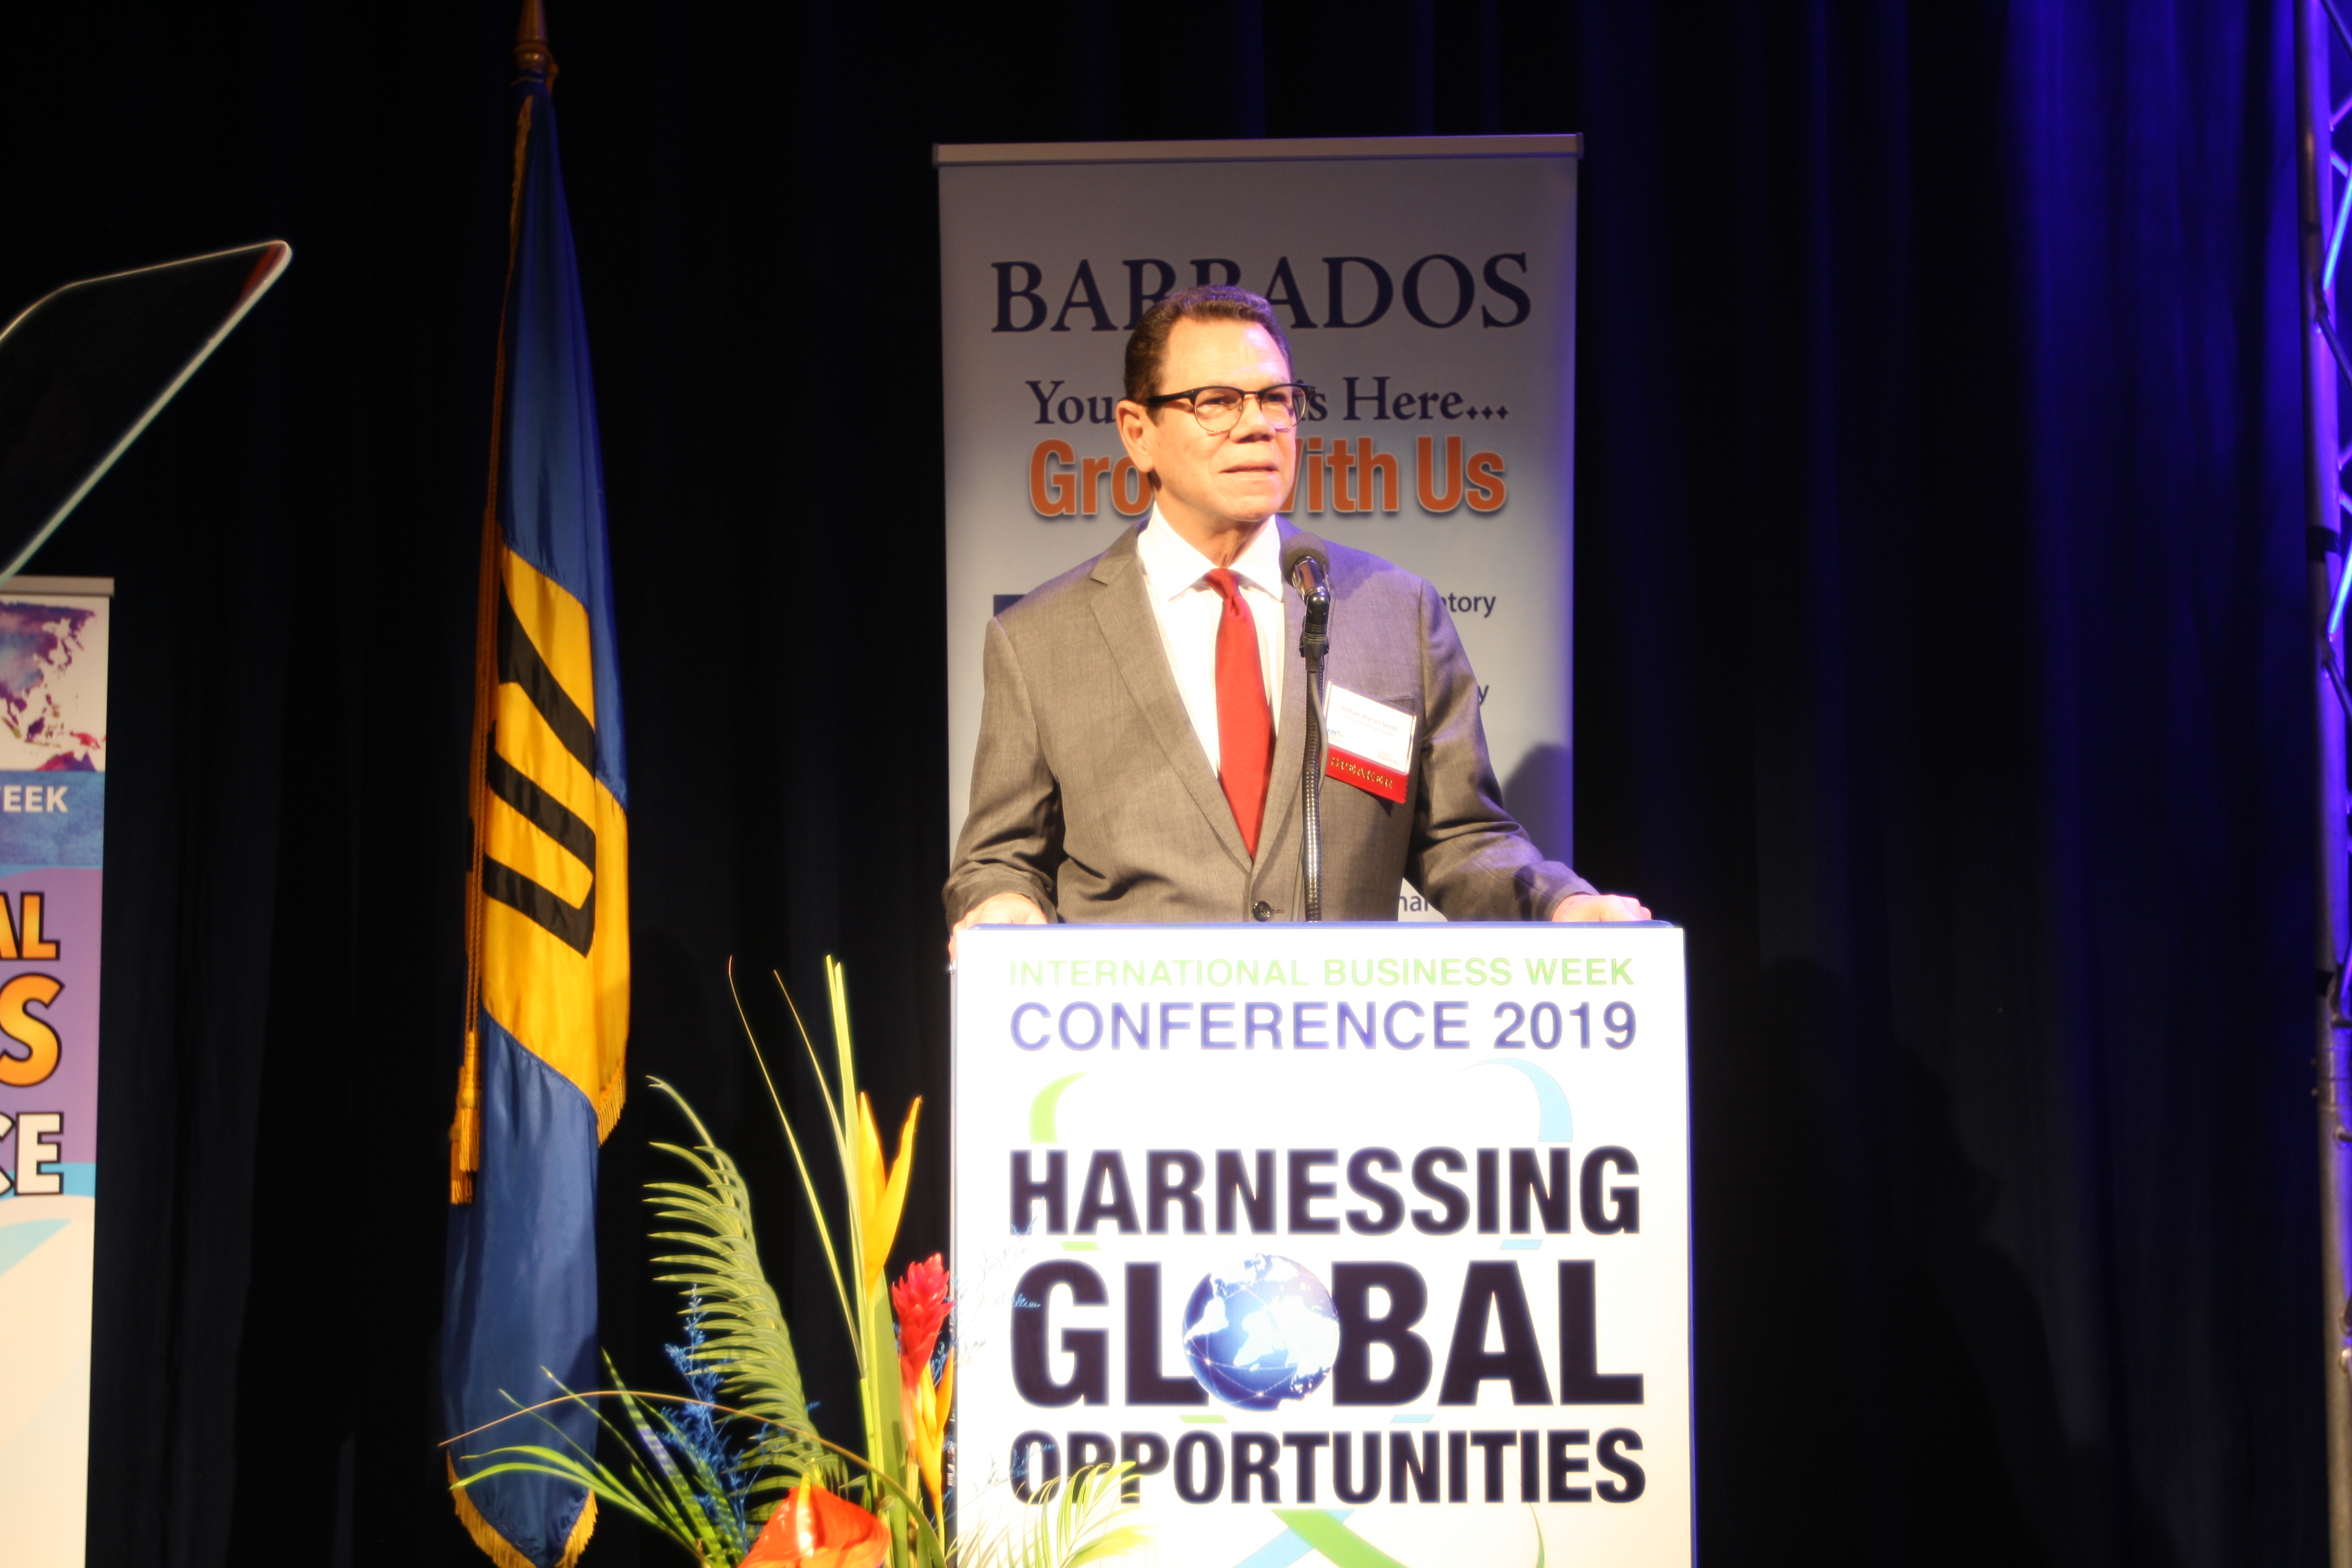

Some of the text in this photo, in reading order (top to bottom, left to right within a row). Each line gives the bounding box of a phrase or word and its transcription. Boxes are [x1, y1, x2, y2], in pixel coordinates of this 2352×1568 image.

[1342, 376, 1509, 422] Here...
[1030, 436, 1507, 517] Gro ith Us
[1340, 705, 1398, 732] William Warren Smith
[1331, 756, 1393, 789] SPEAKER
[0, 784, 68, 813] EEK
[1010, 957, 1635, 987] INTERNATIONAL BUSINESS WEEK
[1011, 1000, 1636, 1051] CONFERENCE 2019
[1009, 1145, 1641, 1236] HARNESSING
[1010, 1253, 1646, 1413] GLOBAL
[1009, 1426, 1650, 1506] OPPORTUNITIES
